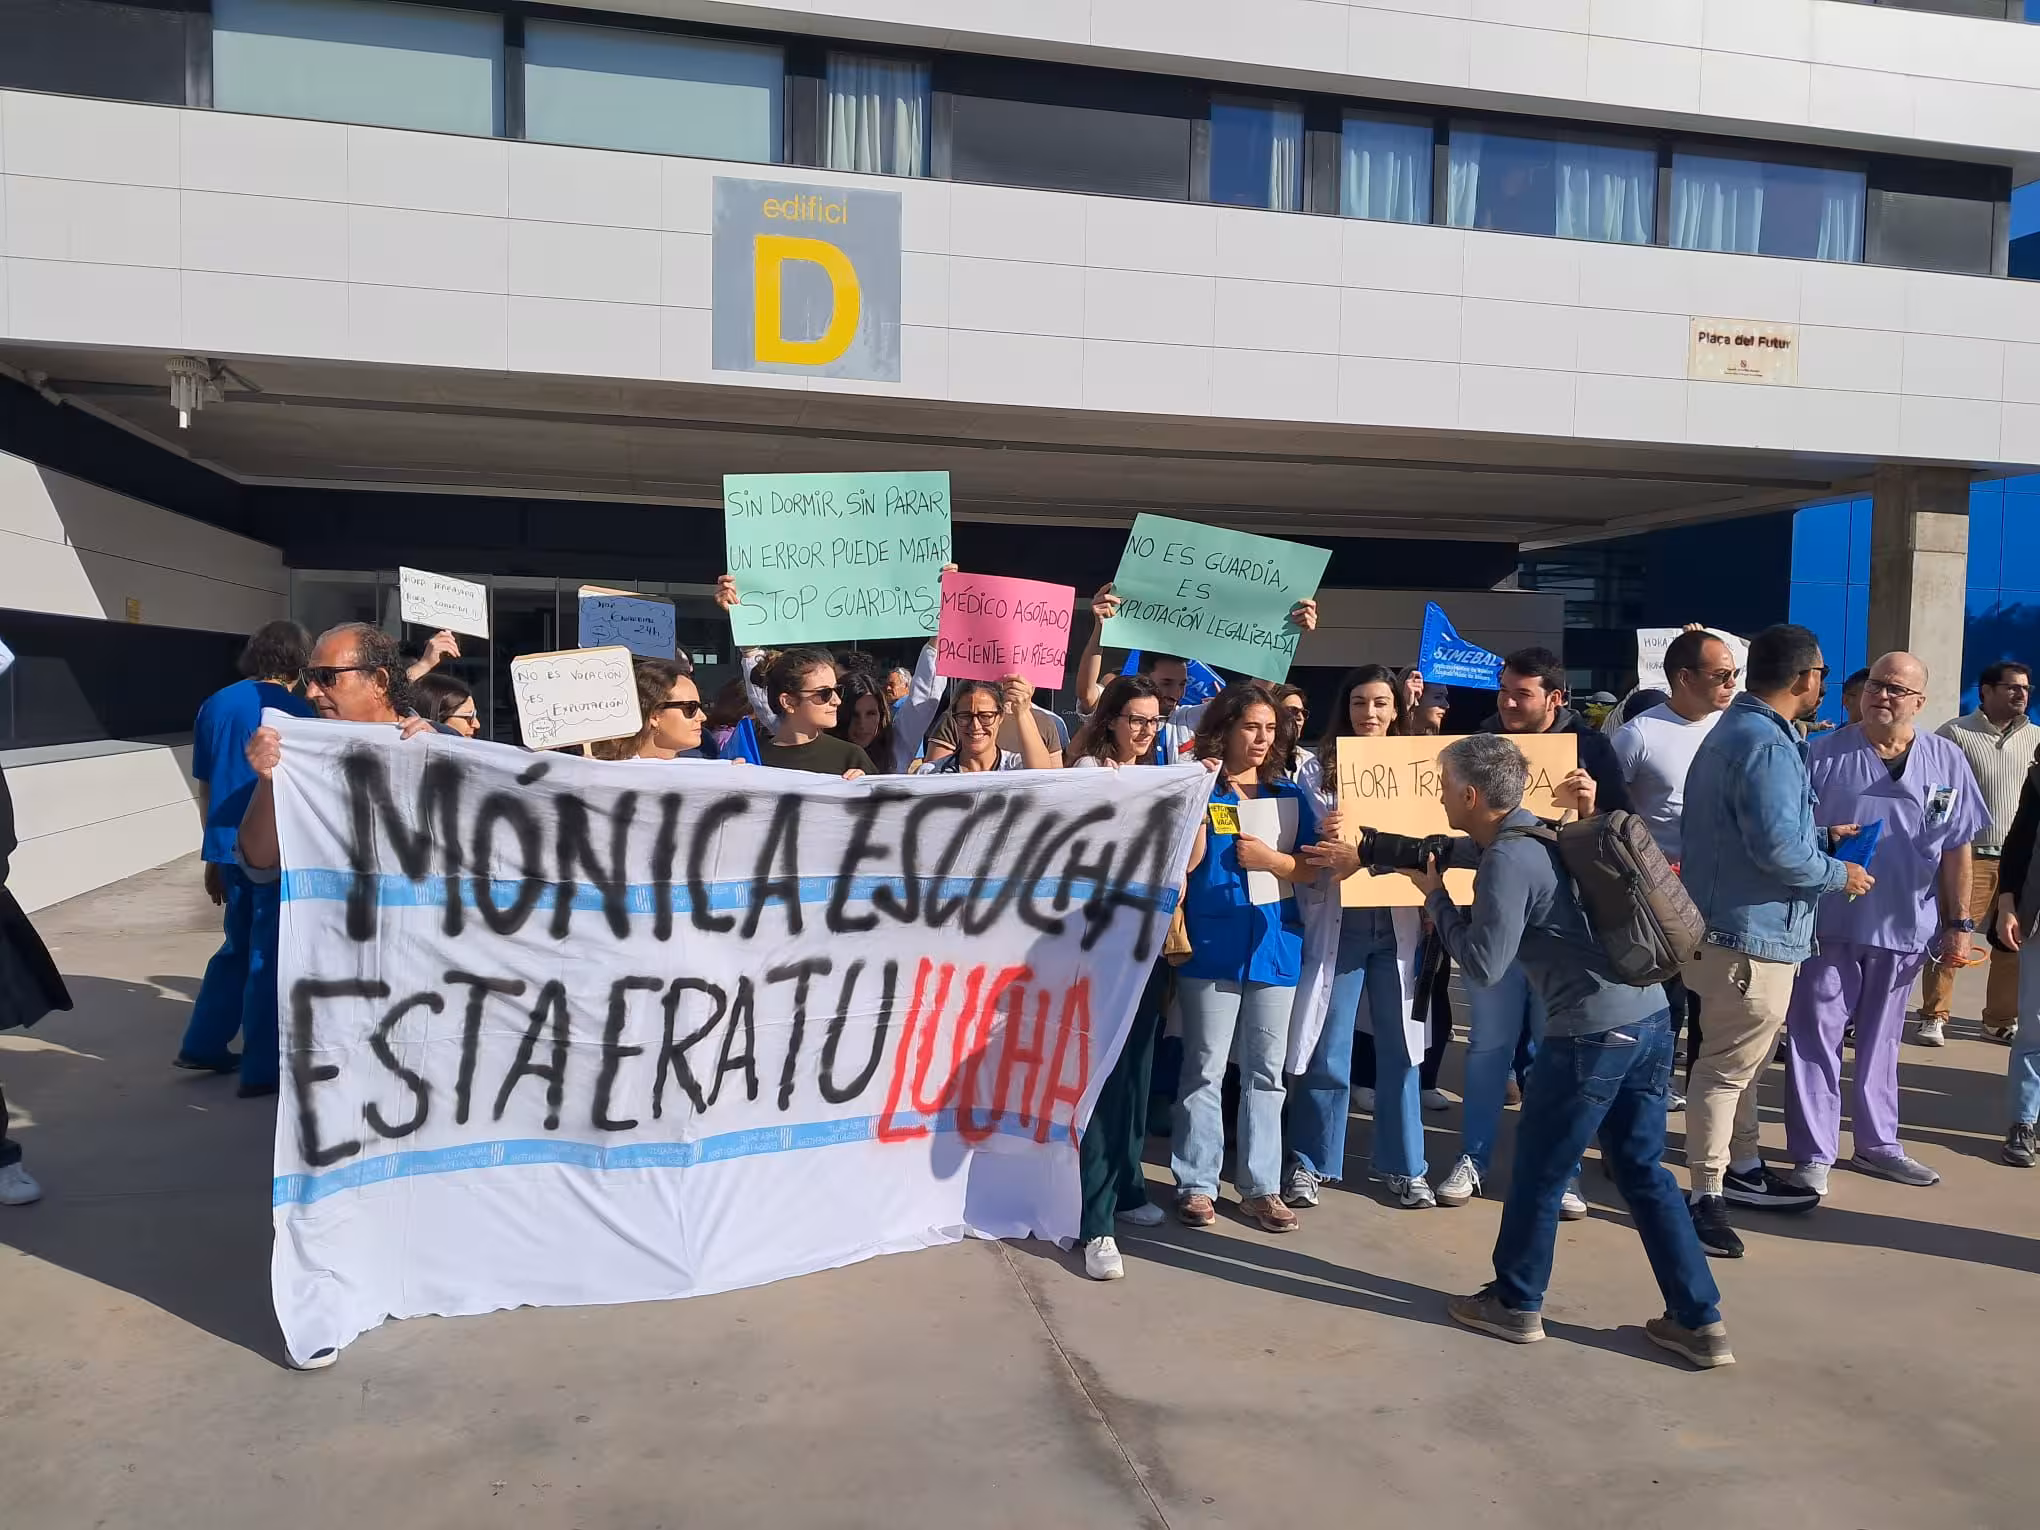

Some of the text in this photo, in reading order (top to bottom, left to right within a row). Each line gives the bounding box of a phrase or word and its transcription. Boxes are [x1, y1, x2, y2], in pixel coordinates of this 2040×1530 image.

[762, 192, 848, 224] edifici
[754, 234, 861, 366] D
[1698, 331, 1791, 349] Plaça del Futur
[885, 485, 950, 519] PARAR,
[729, 534, 951, 571] UN ERROR PUEDE MATAR
[1126, 535, 1155, 558] NO
[1163, 543, 1196, 566] ES
[1176, 578, 1211, 599] ES
[740, 585, 818, 625] STOP
[1013, 601, 1070, 633] AGOTADO,
[1012, 645, 1028, 664] EN
[1434, 647, 1498, 667] SIMEBAL
[518, 669, 538, 680] NO
[547, 671, 561, 679] ES
[529, 695, 544, 704] ES
[1340, 763, 1398, 799] HORA
[345, 748, 1187, 962] MÓNICA ESCUCHA
[292, 957, 1090, 1167] ESTA ERA TU LUCHA
